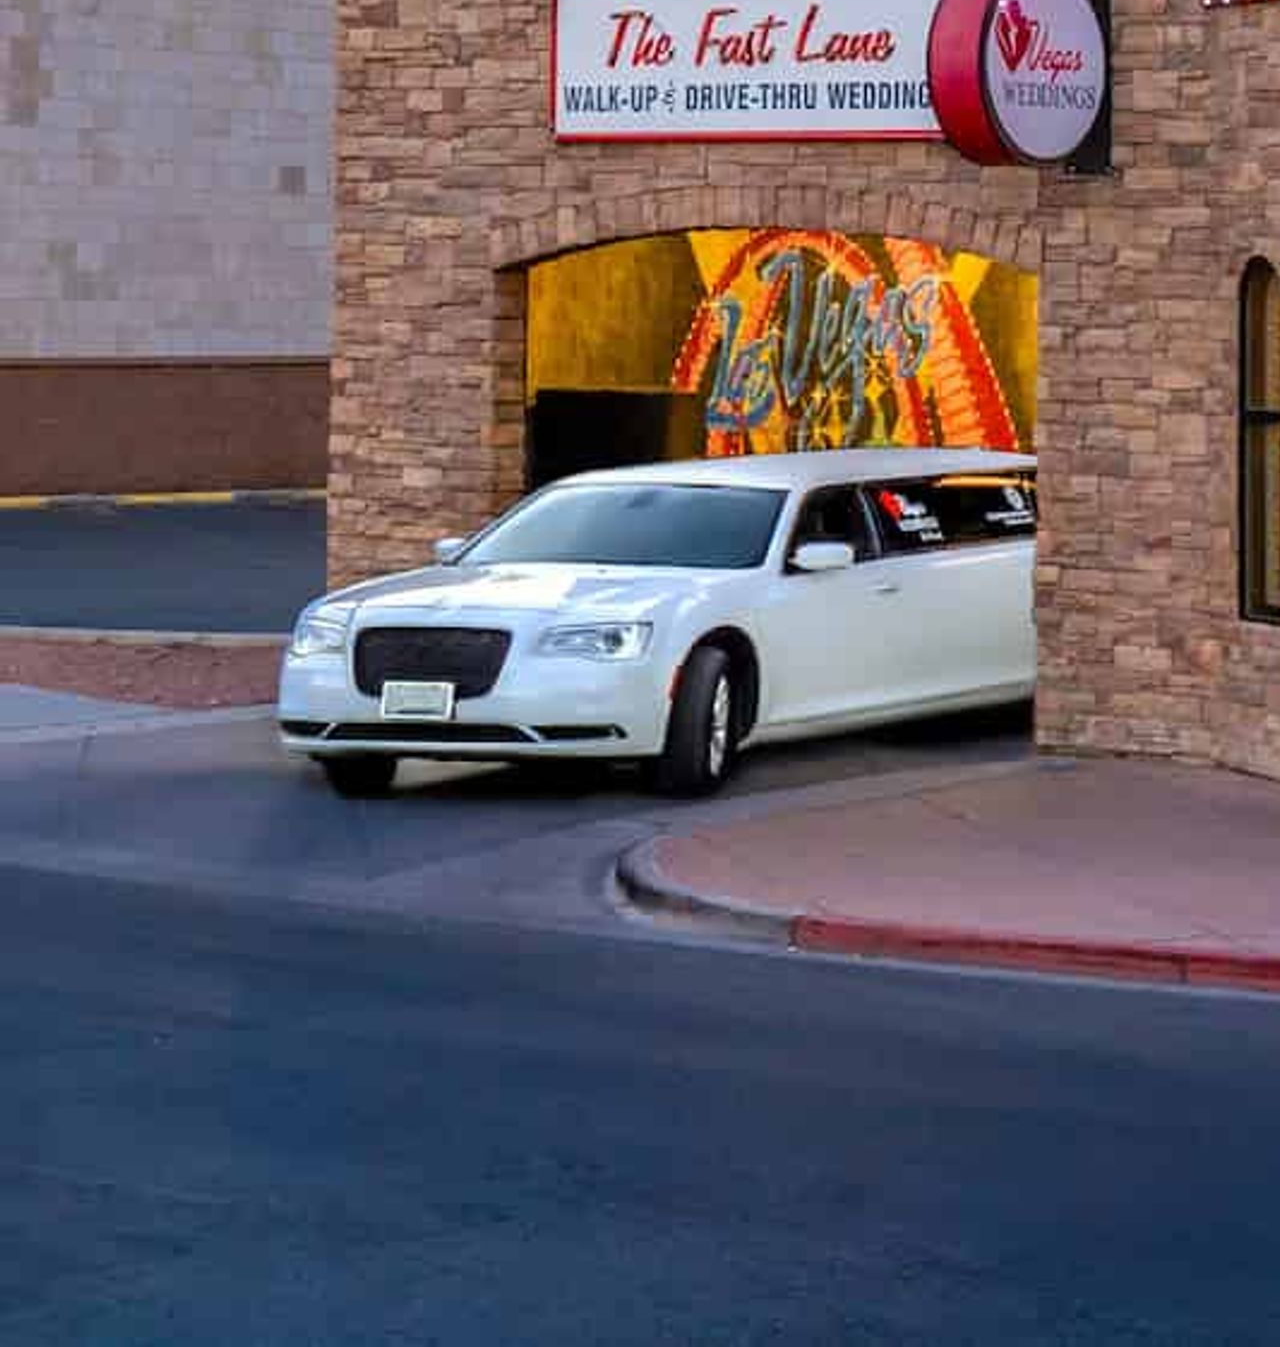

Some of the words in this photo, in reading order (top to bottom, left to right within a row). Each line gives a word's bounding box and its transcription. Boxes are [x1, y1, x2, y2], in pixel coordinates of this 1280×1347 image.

[607, 9, 675, 68] The
[694, 7, 788, 68] Fast
[796, 4, 896, 63] Lane
[1027, 19, 1085, 83] Vegas
[564, 84, 657, 112] WALK-UP
[661, 79, 676, 113] &
[686, 81, 818, 110] DRIVE-THRU
[1004, 80, 1096, 110] WEDDINGS
